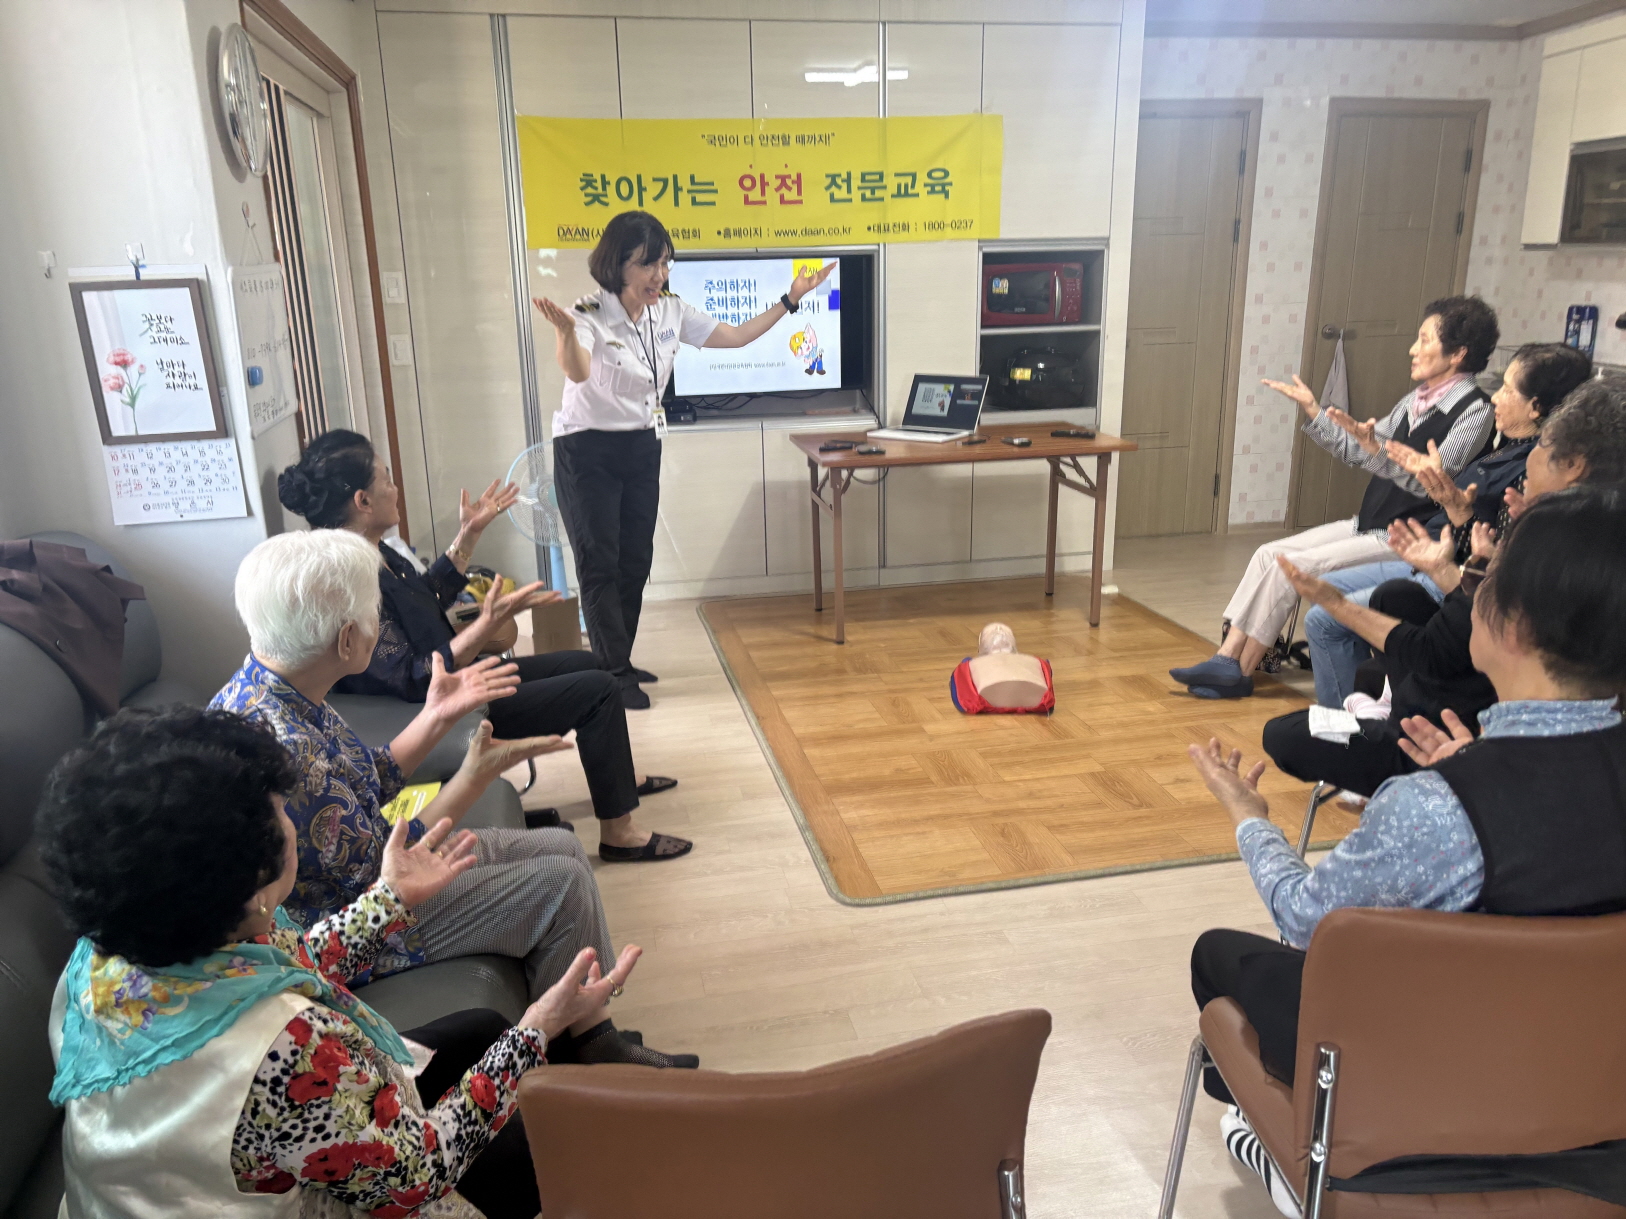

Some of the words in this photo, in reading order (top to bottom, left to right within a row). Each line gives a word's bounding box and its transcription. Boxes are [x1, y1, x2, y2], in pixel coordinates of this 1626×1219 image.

[743, 133, 754, 147] 다
[758, 133, 791, 147] 안전할
[579, 172, 718, 207] 찾아가는
[738, 172, 804, 206] 안전
[823, 167, 953, 203] 전문교육
[774, 225, 852, 238] www.daan.co.kr
[924, 218, 974, 232] 1800-0237
[666, 227, 701, 240] 육협회
[703, 278, 757, 295] 주의하자!
[705, 294, 758, 311] 준비하자!
